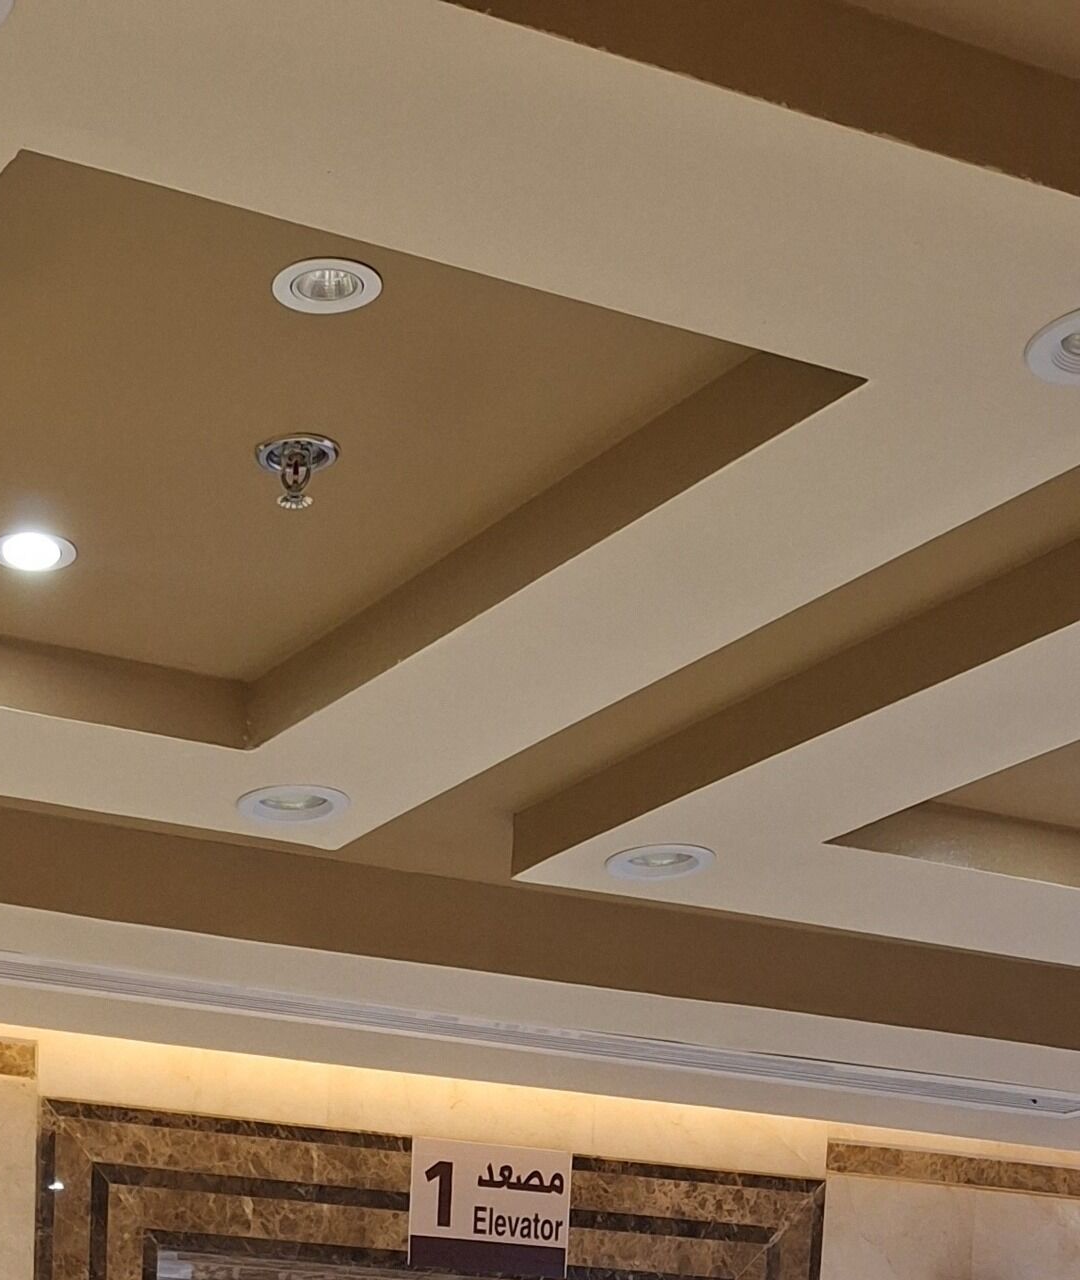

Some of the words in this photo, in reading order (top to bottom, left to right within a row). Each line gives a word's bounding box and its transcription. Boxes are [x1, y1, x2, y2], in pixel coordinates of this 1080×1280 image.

[425, 1160, 453, 1228] 1
[477, 1162, 565, 1195] مصعد
[473, 1205, 564, 1242] Elevator
